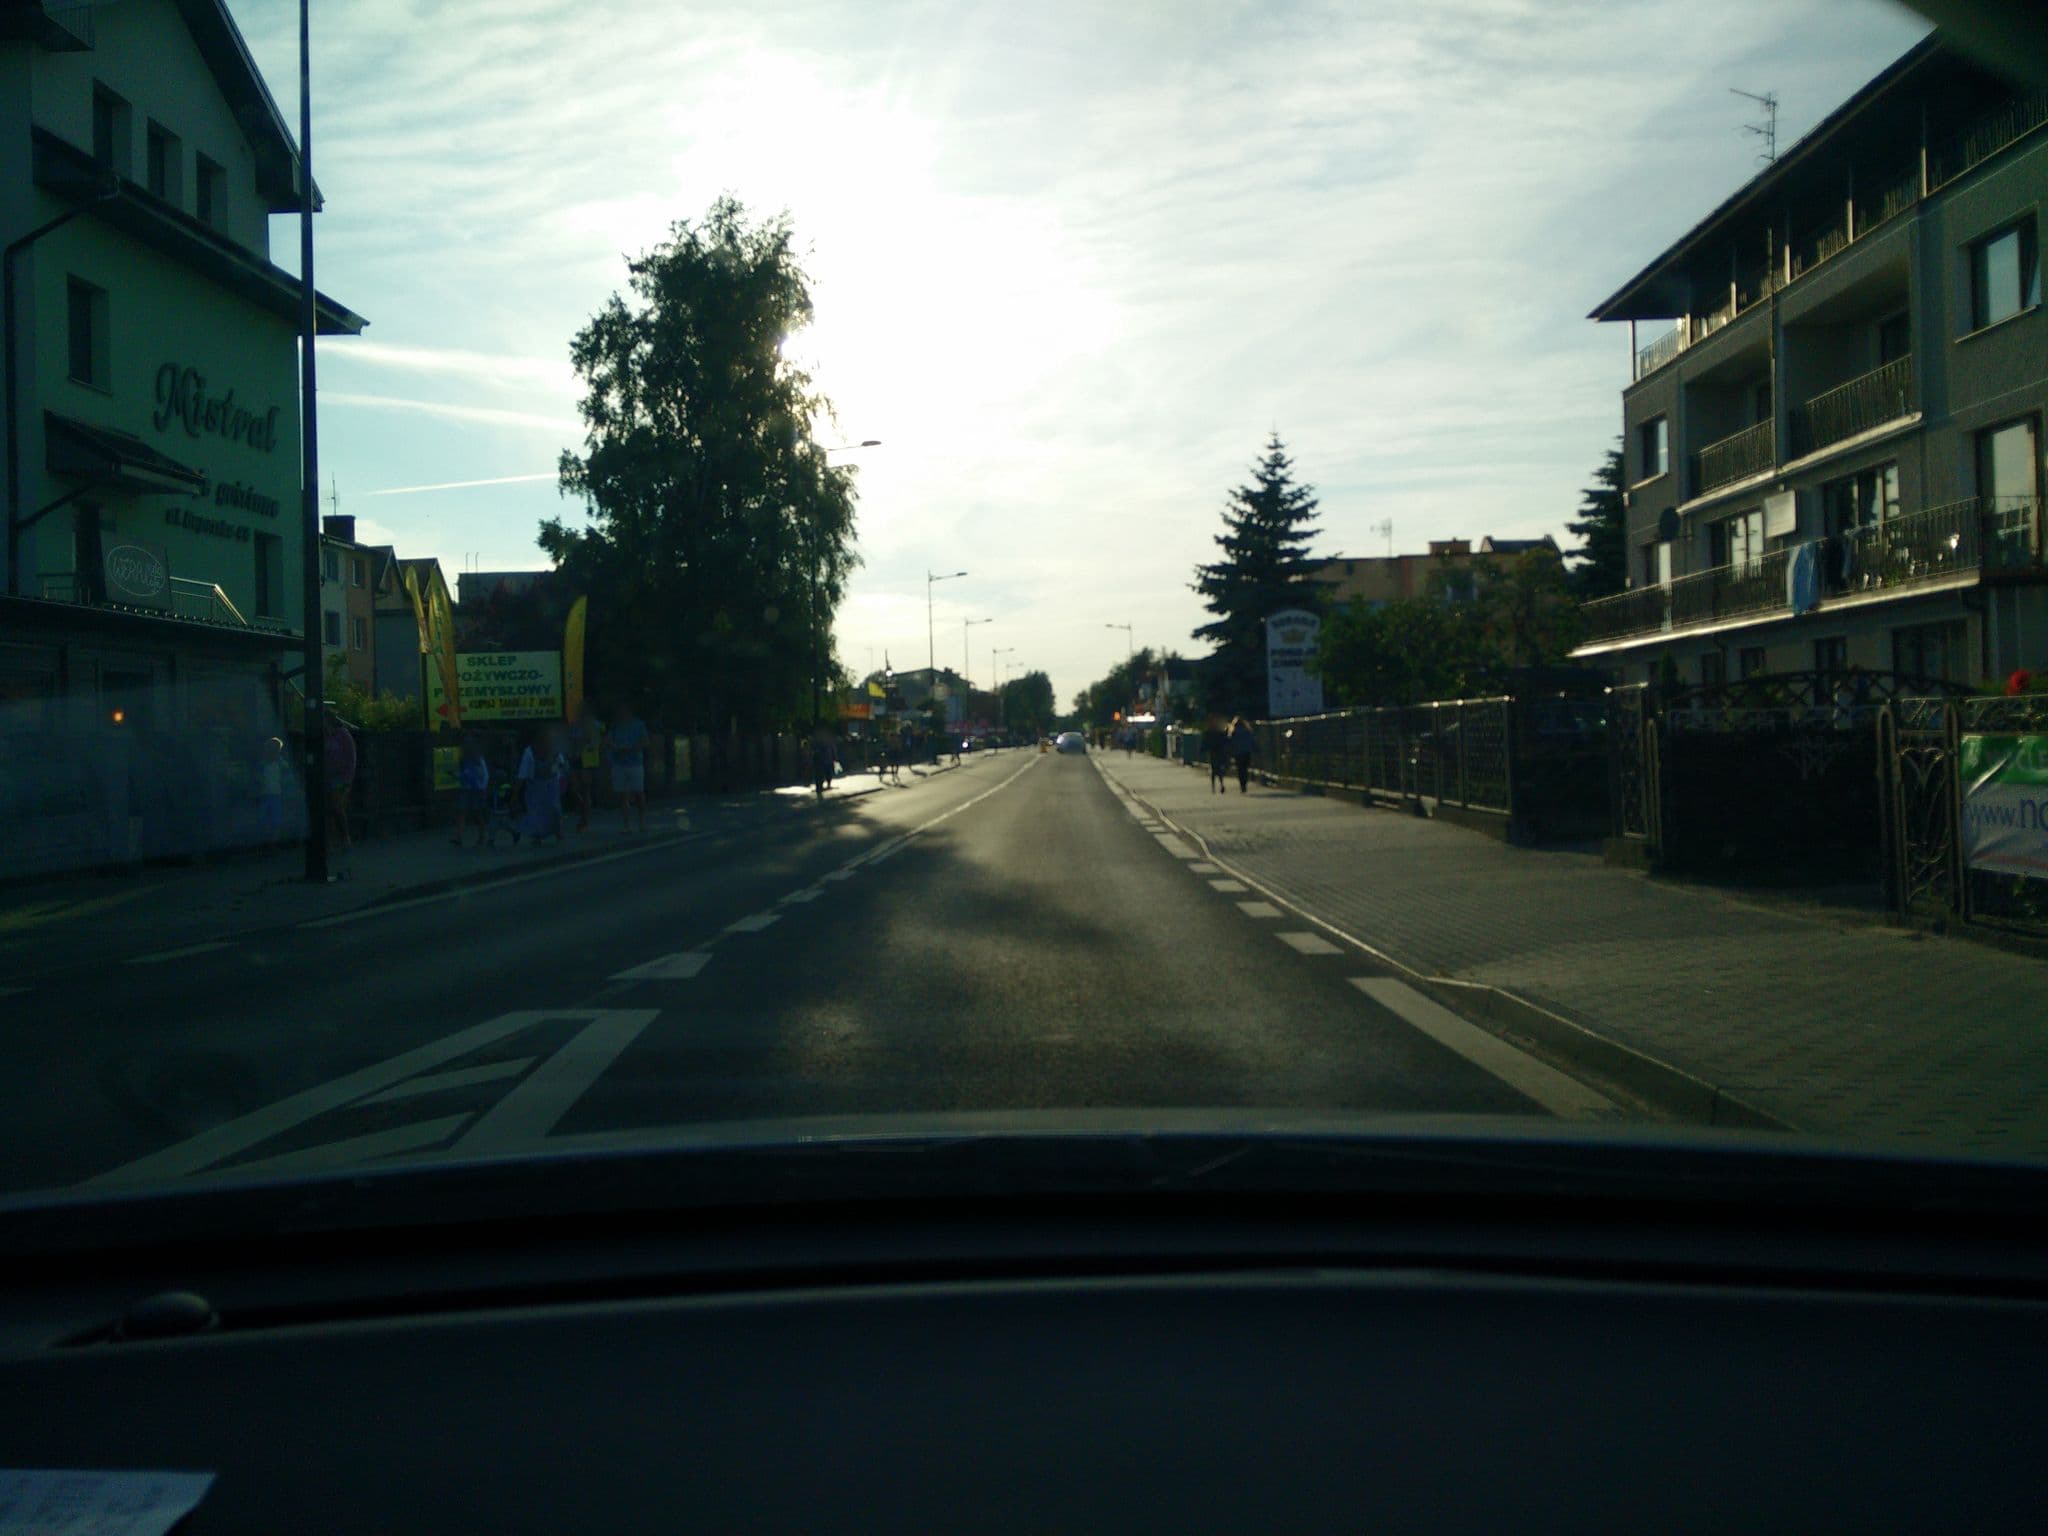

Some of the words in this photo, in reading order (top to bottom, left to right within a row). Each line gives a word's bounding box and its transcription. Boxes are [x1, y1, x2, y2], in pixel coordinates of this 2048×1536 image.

[153, 362, 280, 452] Mistral
[466, 656, 517, 666] SKLEP
[457, 669, 544, 682] OŻYWCZO-
[434, 684, 551, 698] PZEMYSŁOWY
